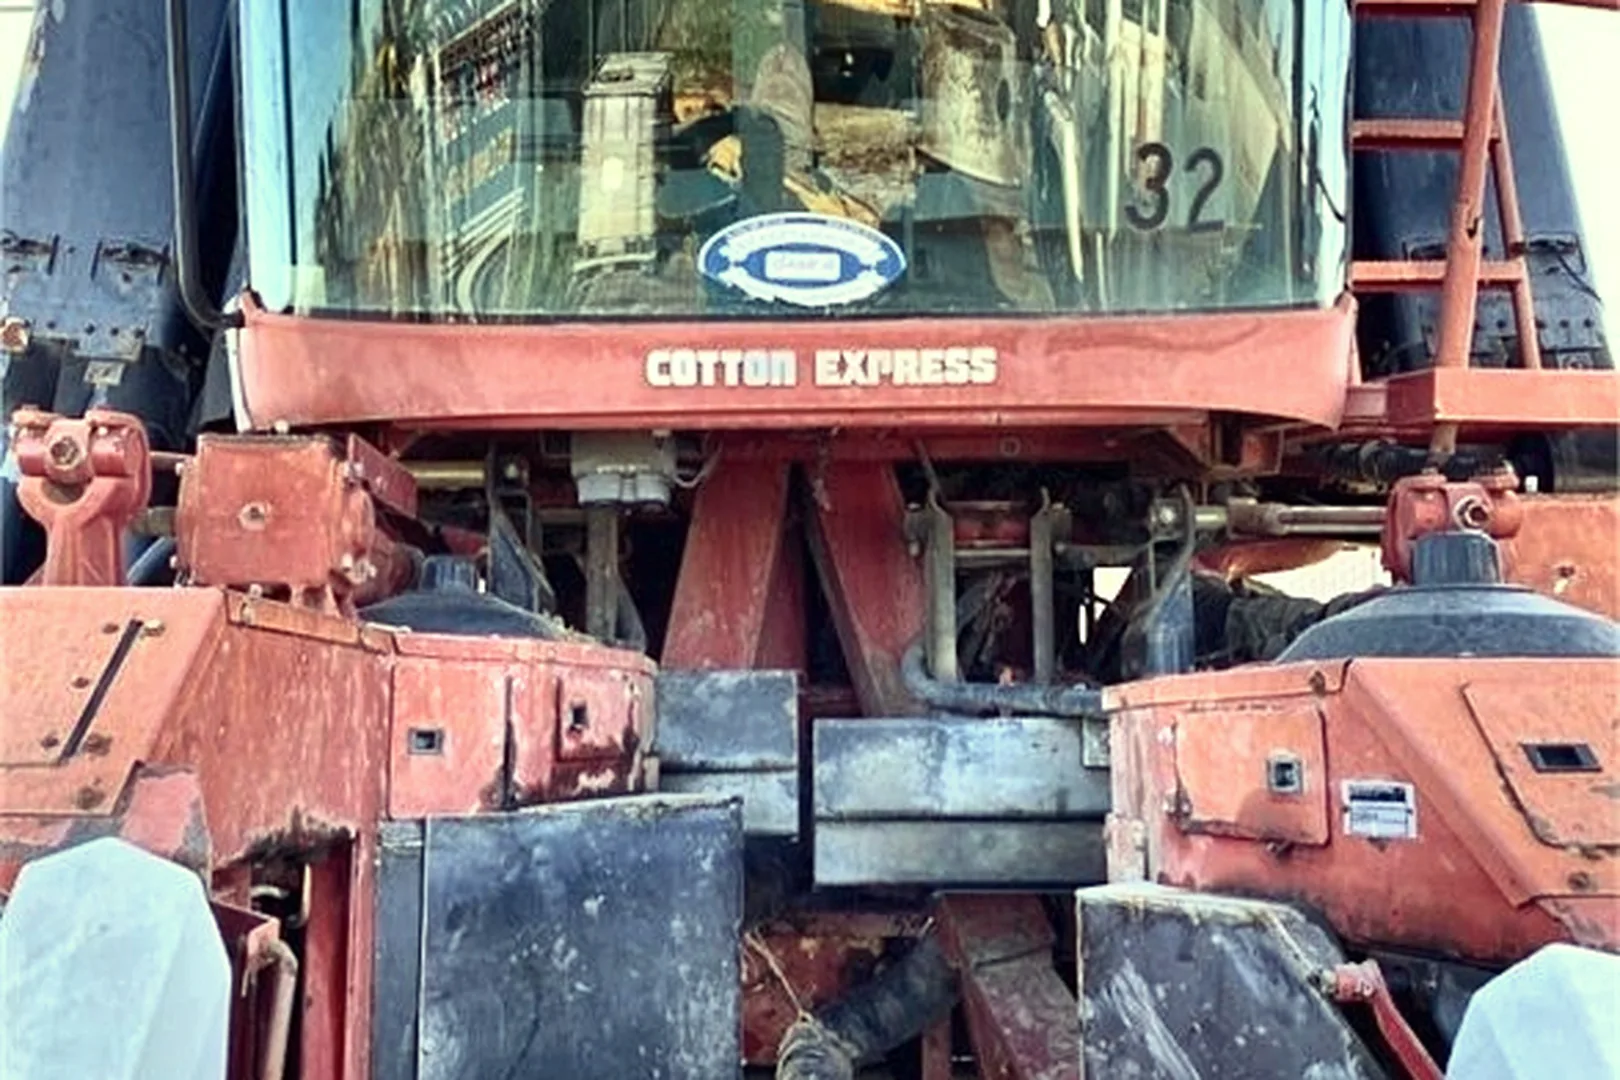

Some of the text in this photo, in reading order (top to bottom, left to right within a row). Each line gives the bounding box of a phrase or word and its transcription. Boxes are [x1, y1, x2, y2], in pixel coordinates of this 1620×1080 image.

[1124, 142, 1224, 233] 32
[646, 347, 997, 387] COTTON EXPRESS
